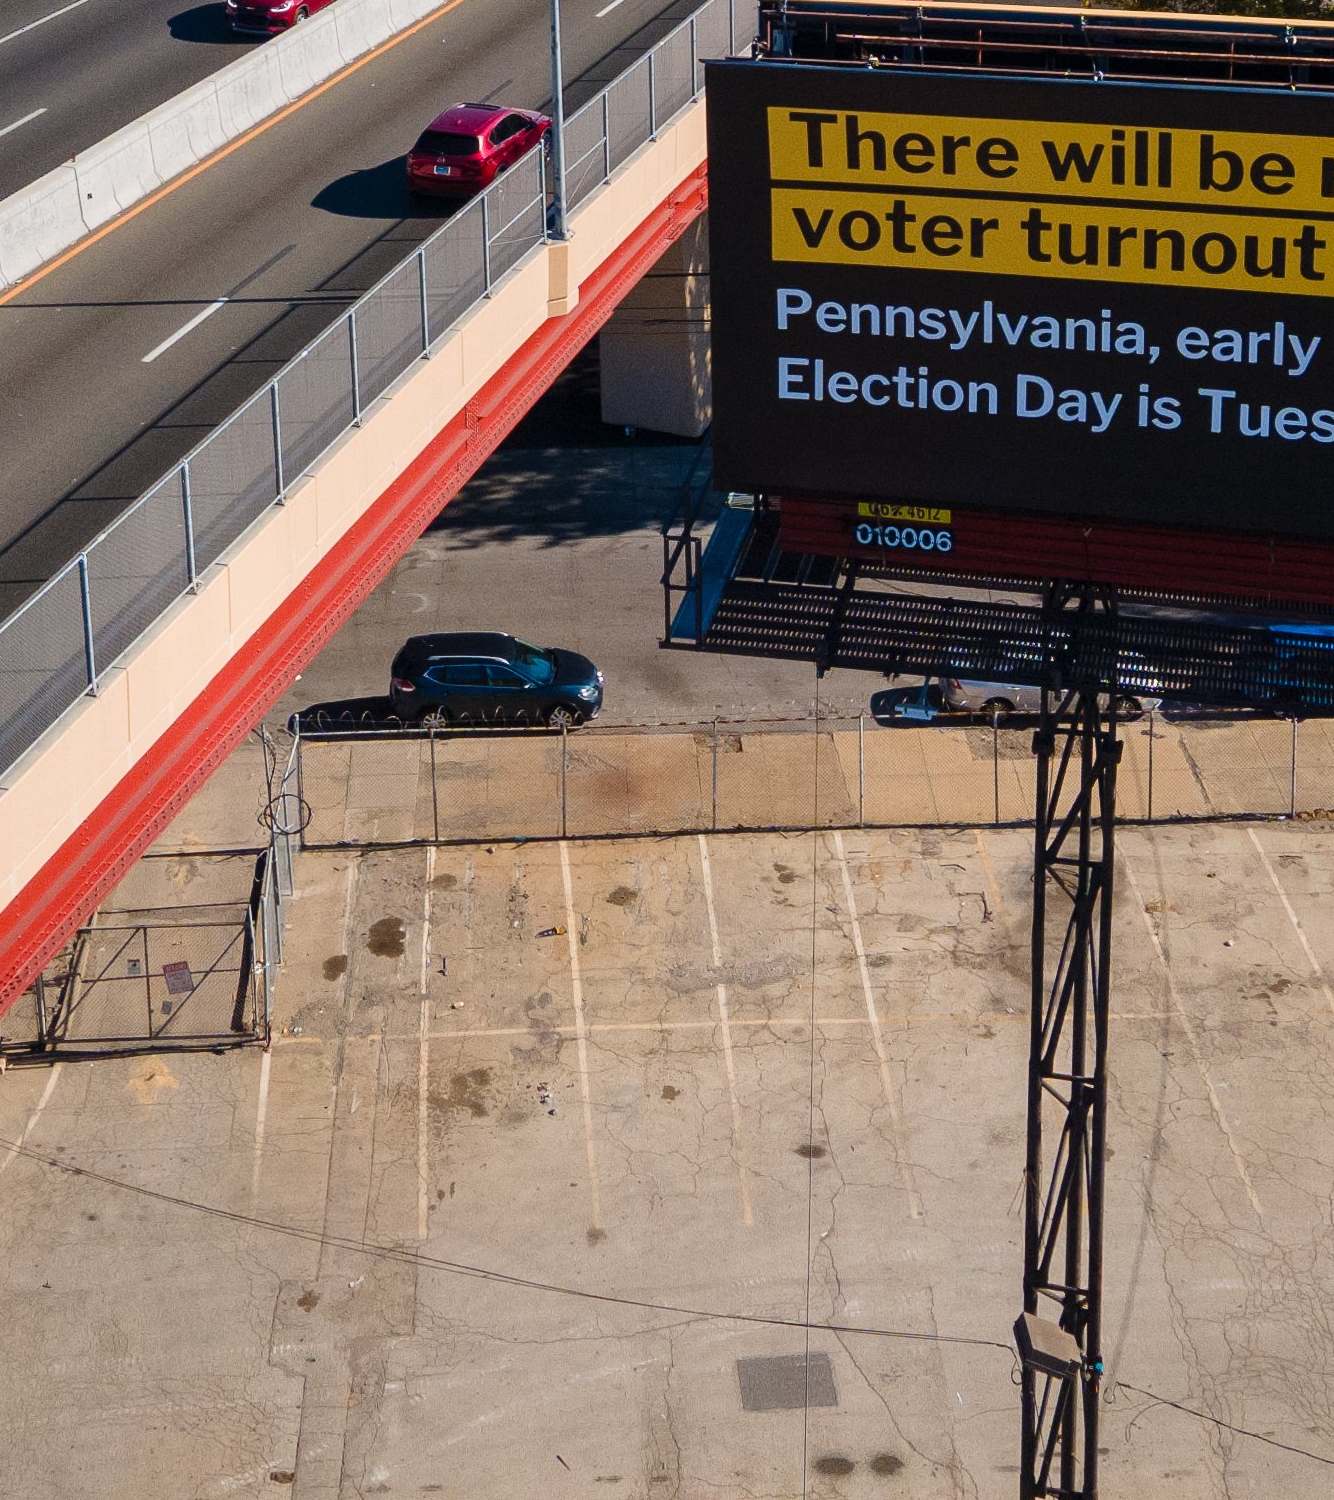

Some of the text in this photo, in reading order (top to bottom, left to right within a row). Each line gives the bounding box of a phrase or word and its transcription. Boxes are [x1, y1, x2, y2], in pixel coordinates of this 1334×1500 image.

[788, 111, 1020, 179] There
[1041, 128, 1173, 189] will
[1199, 133, 1296, 196] be
[791, 199, 1000, 259] voter
[1020, 207, 1327, 282] turnout
[776, 288, 1160, 364] Pennsylvania,
[1176, 321, 1322, 376] early
[778, 356, 998, 415] Election
[1016, 373, 1123, 433] Day
[1138, 383, 1182, 430] is
[856, 523, 952, 552] 010006
